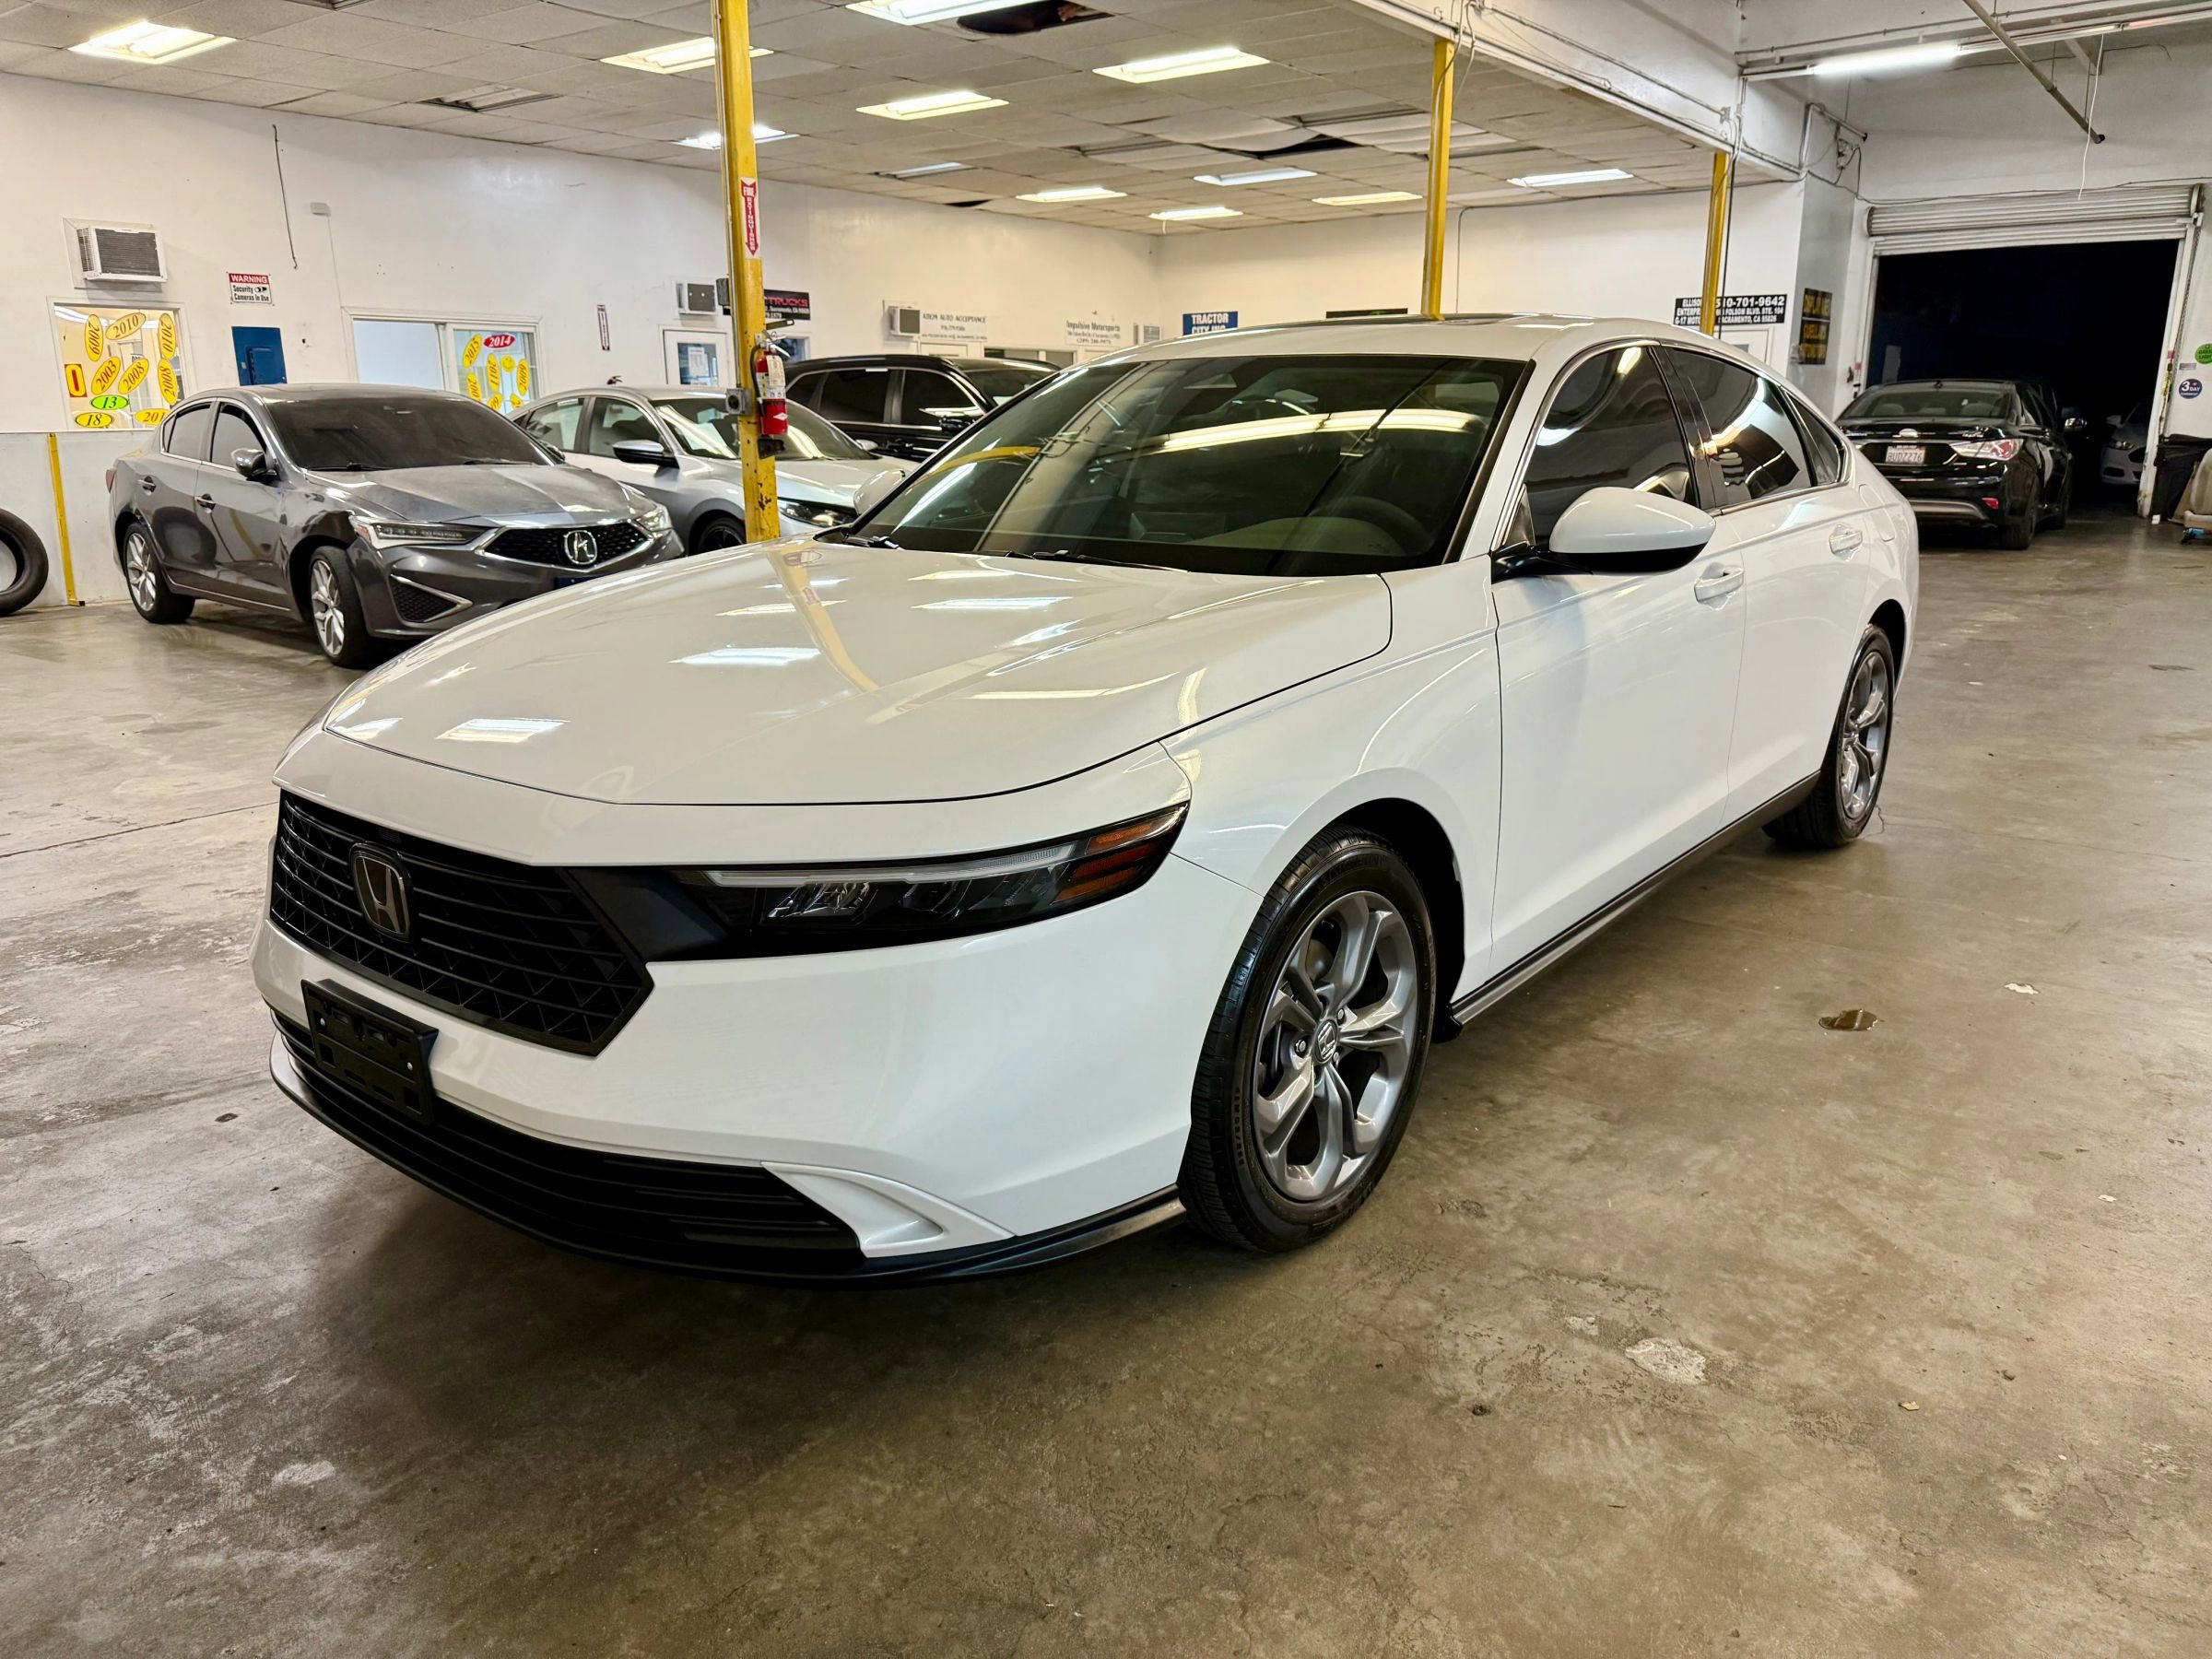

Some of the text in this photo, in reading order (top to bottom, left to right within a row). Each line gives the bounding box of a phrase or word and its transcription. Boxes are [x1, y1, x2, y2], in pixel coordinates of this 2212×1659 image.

[230, 275, 267, 284] WARNING
[232, 285, 253, 294] Security
[767, 296, 808, 307] TRUCKS
[1682, 299, 1701, 307] ELLISO
[1715, 296, 1785, 308] 510-701-9642
[1191, 312, 1230, 324] TRACTOR
[112, 314, 139, 338] 2010
[88, 322, 100, 356] 2009
[161, 322, 173, 353] 2010
[488, 335, 512, 347] 2014
[96, 359, 117, 391] 2003
[123, 361, 146, 390] 2008
[488, 359, 499, 385] 2011
[159, 365, 175, 397] 2008
[2181, 381, 2191, 392] 3
[467, 377, 479, 398] 200
[101, 396, 118, 409] 13
[87, 414, 102, 426] 18
